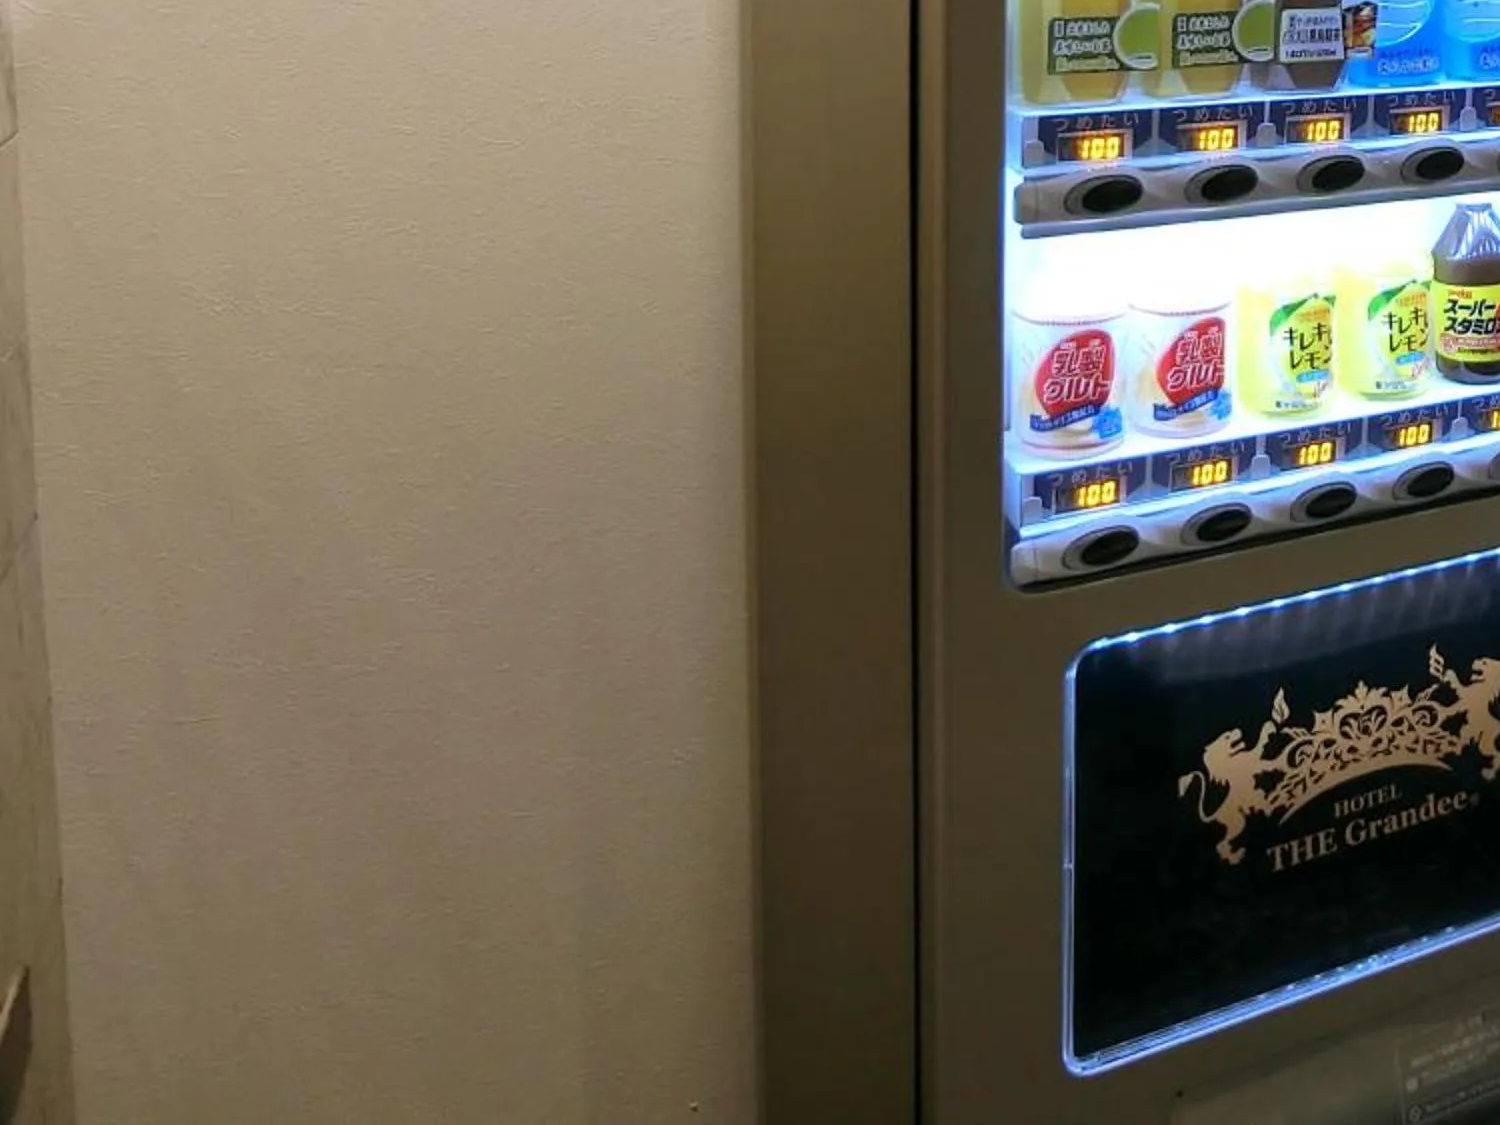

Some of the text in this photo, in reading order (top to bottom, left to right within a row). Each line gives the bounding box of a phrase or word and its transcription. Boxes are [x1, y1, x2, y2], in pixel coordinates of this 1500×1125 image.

[1172, 106, 1253, 122] つめたい
[1409, 112, 1439, 133] 100
[1199, 128, 1235, 151] 100
[1307, 120, 1340, 142] 100
[1079, 136, 1120, 161] 100
[1444, 299, 1496, 315] スーパー
[1399, 424, 1430, 446] 100
[1299, 442, 1332, 465] 100
[1191, 461, 1228, 485] 100
[1077, 481, 1116, 507] 100
[1334, 784, 1403, 818] HOTEL
[1266, 790, 1469, 873] THE Grandee
